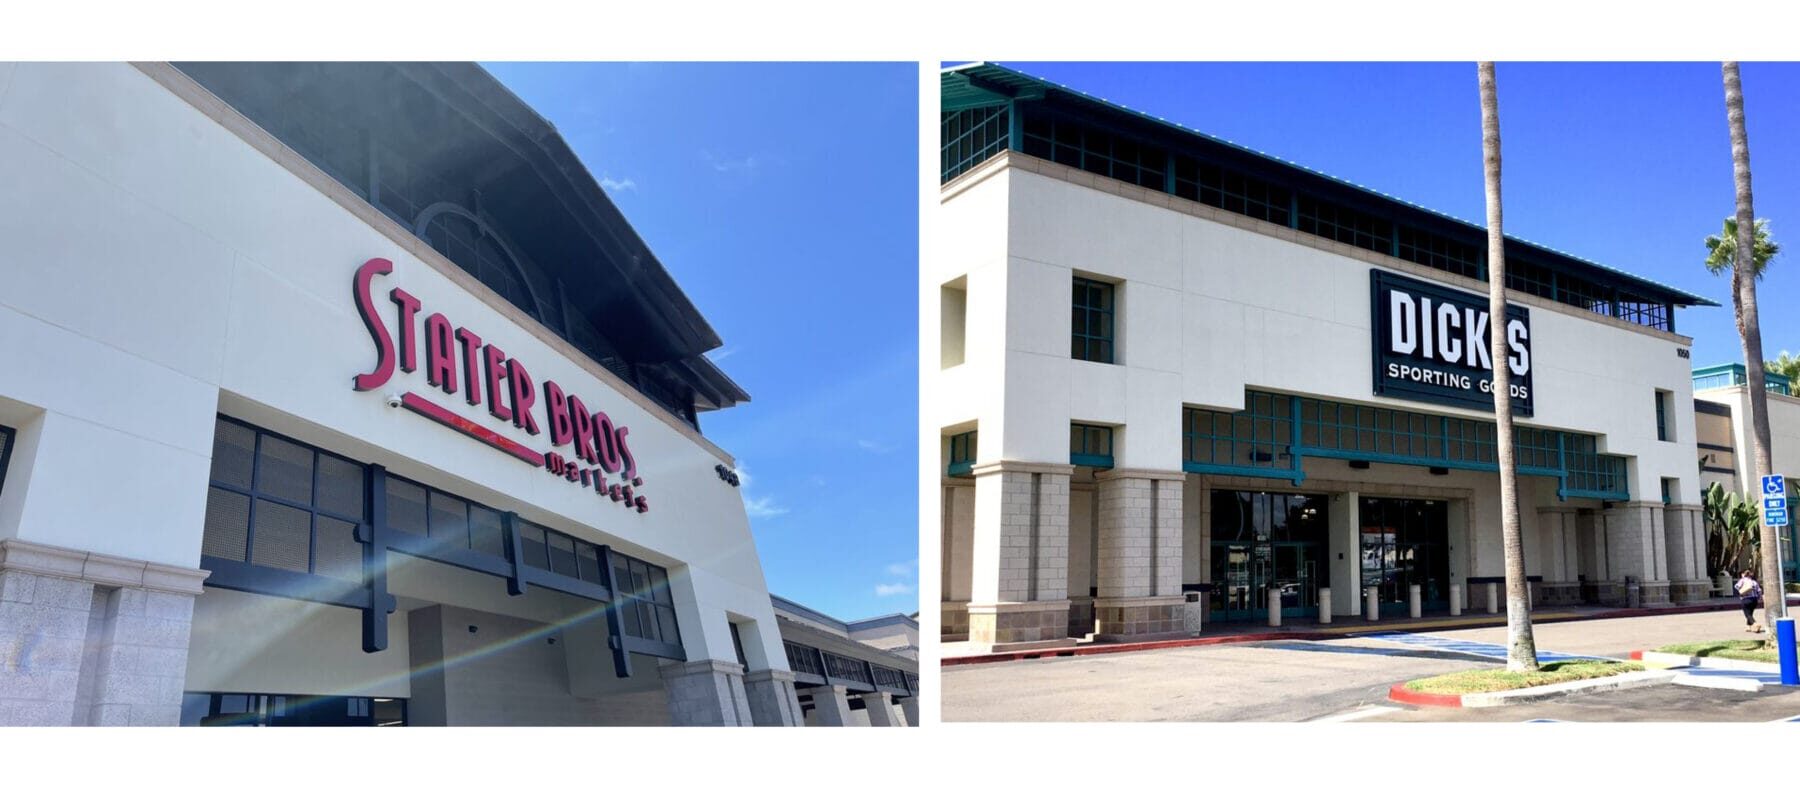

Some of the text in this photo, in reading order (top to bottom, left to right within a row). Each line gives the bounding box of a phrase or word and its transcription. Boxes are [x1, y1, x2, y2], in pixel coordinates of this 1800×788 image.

[1390, 289, 1529, 376] DICKS
[353, 257, 643, 487] STATER BROS.
[1388, 363, 1528, 399] SPORTING GDS
[544, 451, 648, 513] markets
